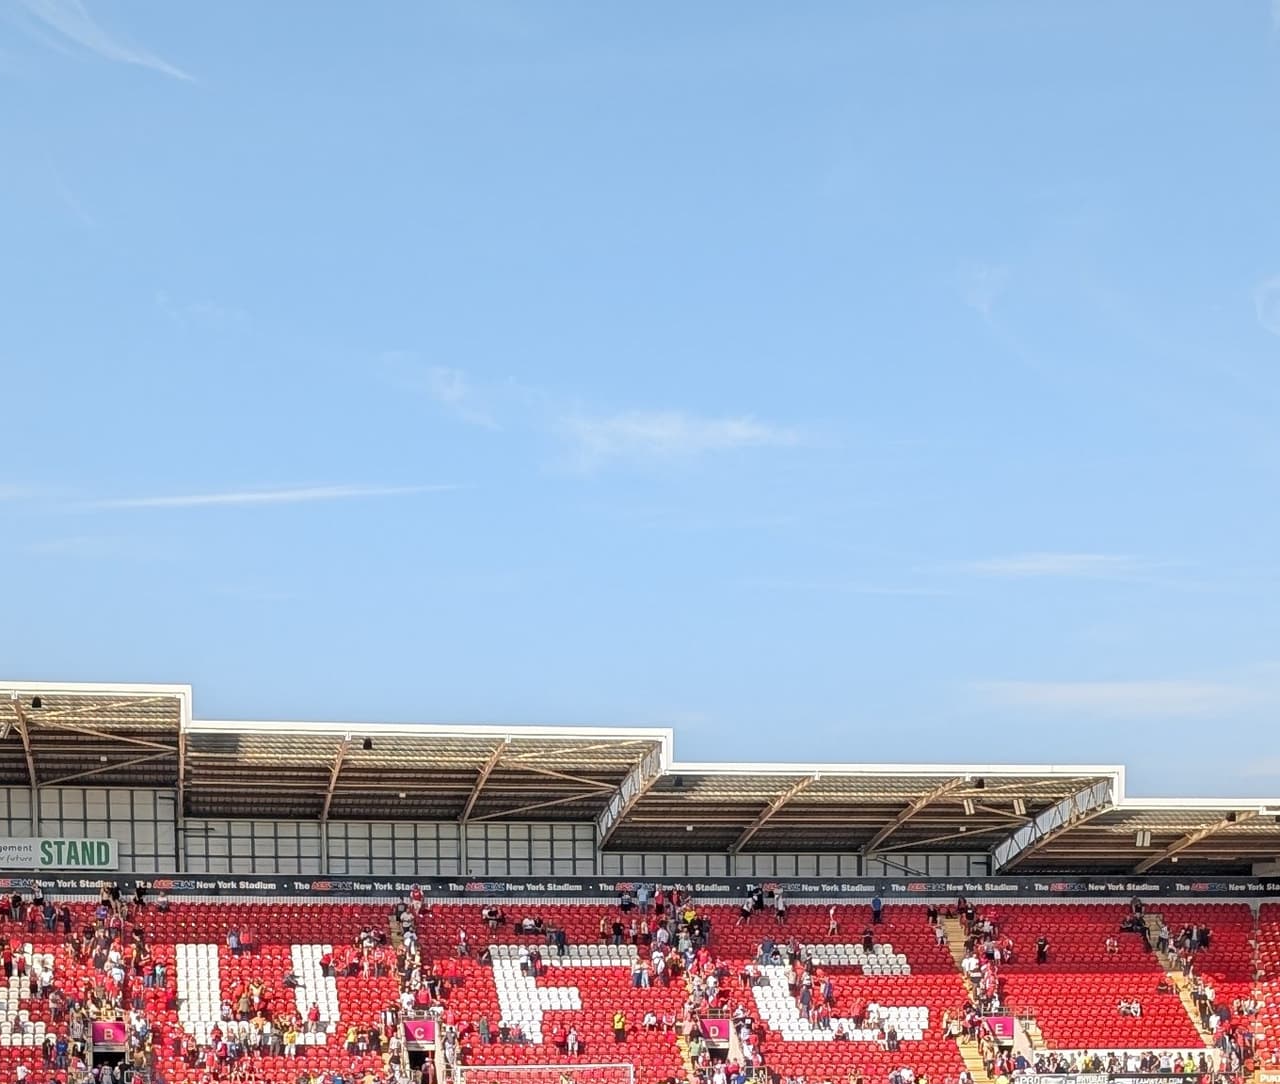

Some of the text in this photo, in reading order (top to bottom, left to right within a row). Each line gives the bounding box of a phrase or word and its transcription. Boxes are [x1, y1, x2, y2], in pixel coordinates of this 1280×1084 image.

[40, 840, 110, 865] STAND
[35, 879, 55, 888] New
[57, 879, 78, 888] York
[196, 880, 215, 890] New
[217, 880, 237, 890] York
[239, 880, 276, 890] Stadium
[294, 881, 393, 891] The New York
[449, 883, 582, 891] The New York Stadium
[696, 883, 730, 892] Stadium
[802, 883, 875, 892] New York Stadium
[946, 883, 963, 892] New
[965, 883, 983, 892] York
[984, 883, 1018, 892] Stadium
[1088, 883, 1106, 892] New
[1107, 883, 1124, 892] York
[1126, 883, 1160, 892] Stadium
[1229, 883, 1246, 891] New
[1248, 883, 1264, 891] York
[414, 1028, 424, 1039] C
[710, 1026, 719, 1037] D
[995, 1024, 1003, 1035] E
[105, 1029, 115, 1040] B
